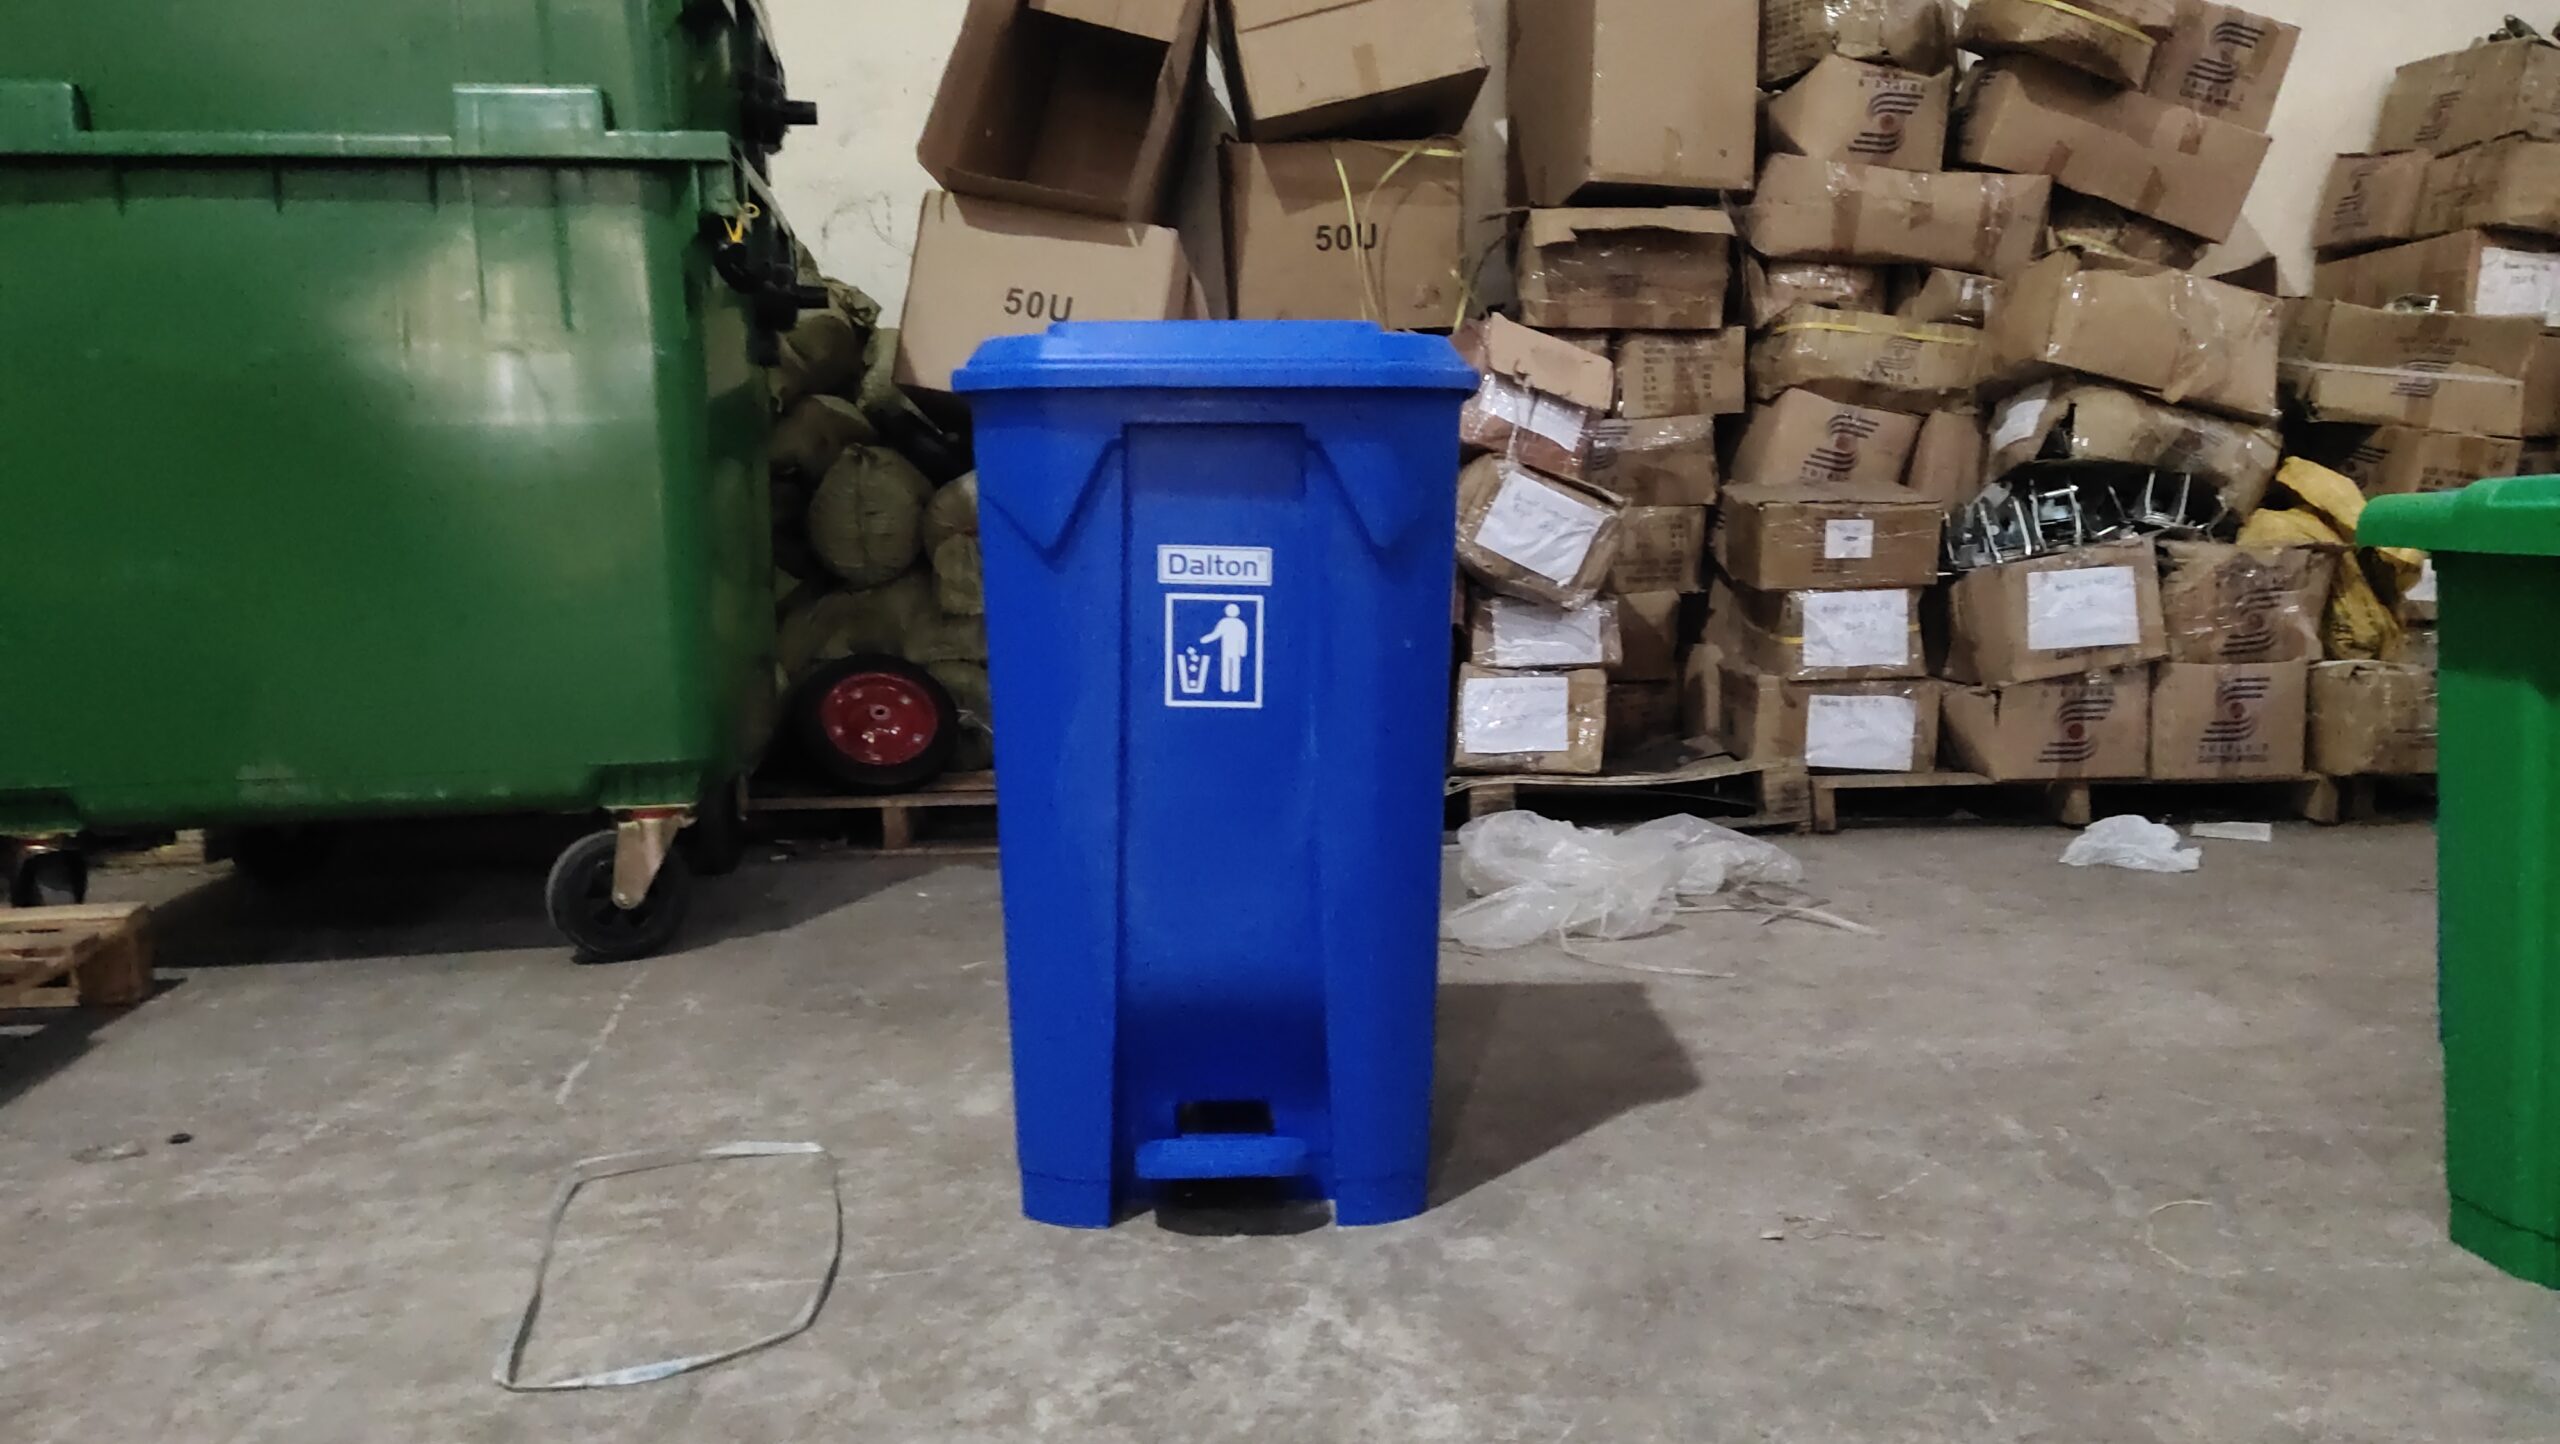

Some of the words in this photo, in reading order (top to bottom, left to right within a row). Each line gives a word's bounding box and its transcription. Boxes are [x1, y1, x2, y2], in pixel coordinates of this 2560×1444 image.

[1315, 222, 1377, 251] 50U
[1003, 287, 1073, 322] 50U
[1168, 553, 1258, 576] Dalton
